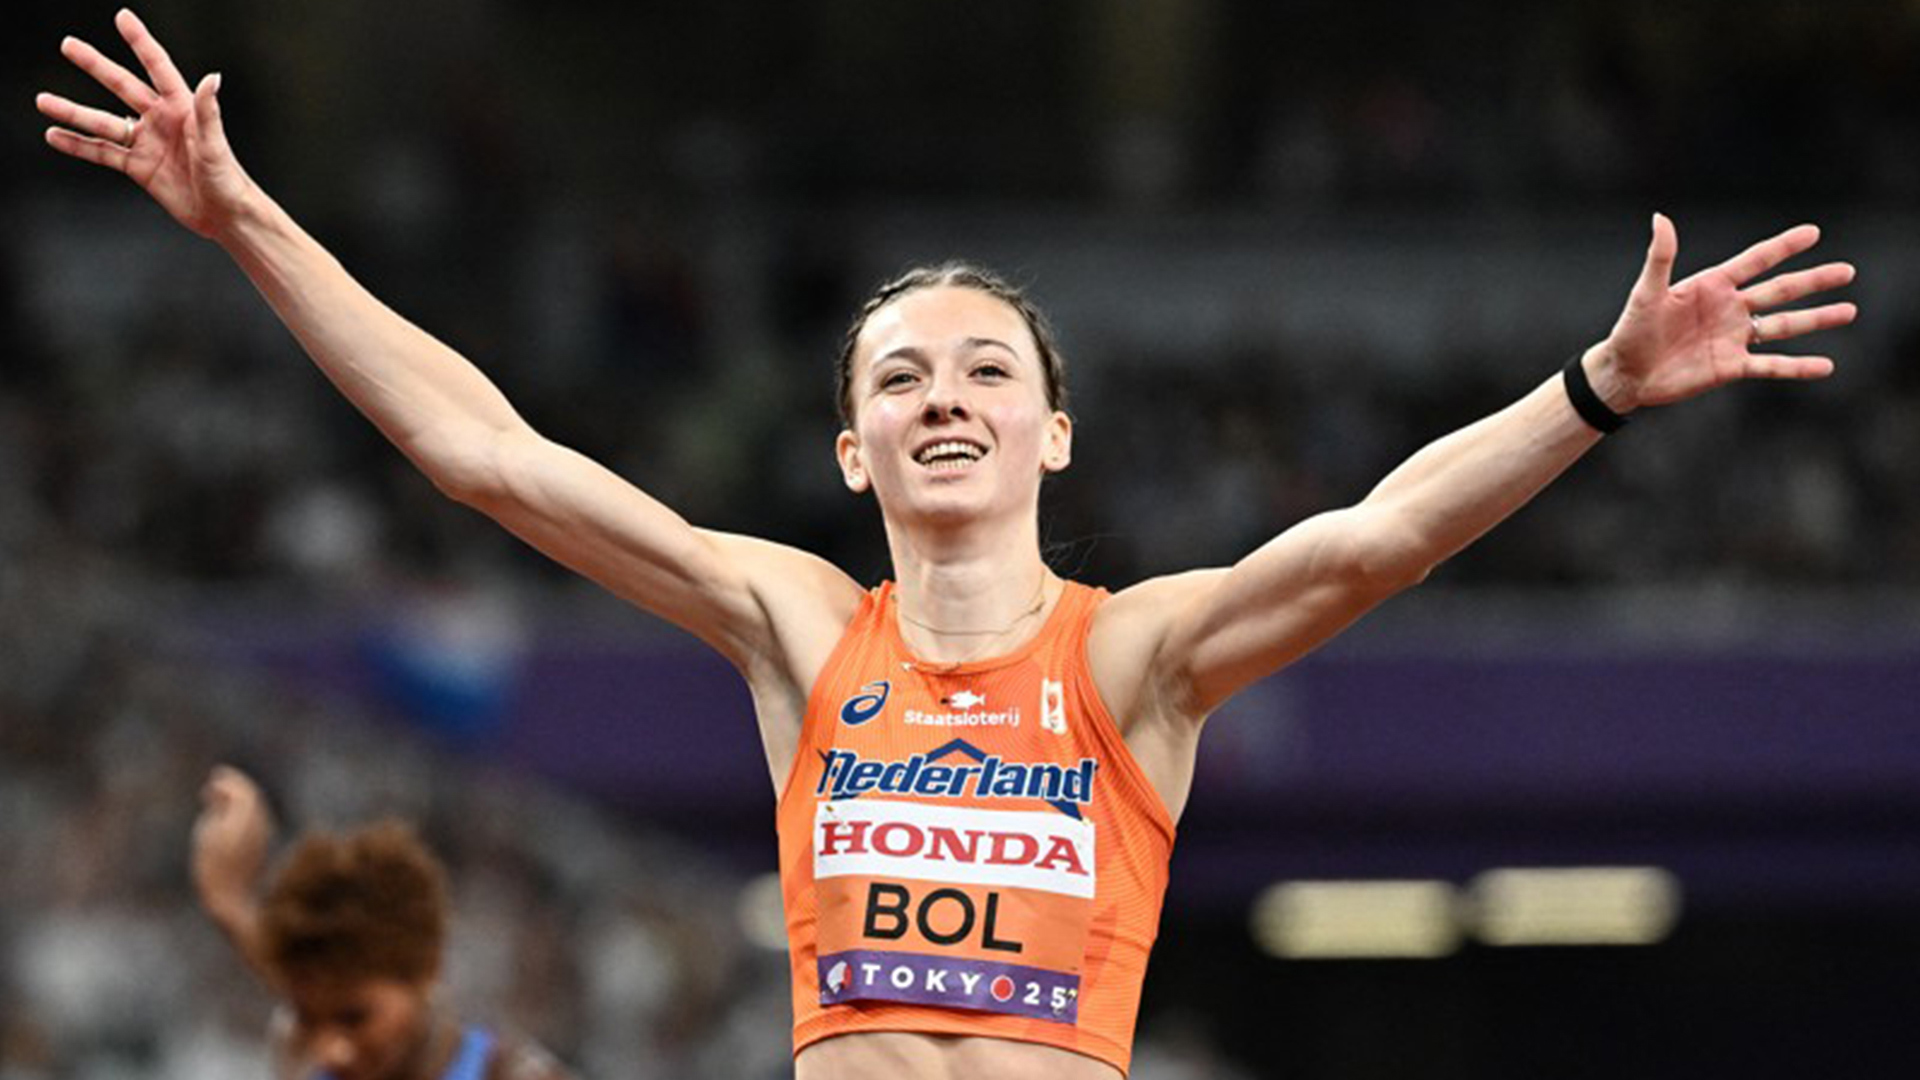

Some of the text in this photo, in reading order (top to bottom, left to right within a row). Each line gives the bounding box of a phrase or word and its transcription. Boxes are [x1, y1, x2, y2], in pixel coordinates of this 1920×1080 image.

[903, 709, 1020, 727] Staatsloterij
[818, 820, 1090, 876] HONDA
[863, 882, 1023, 953] BOL
